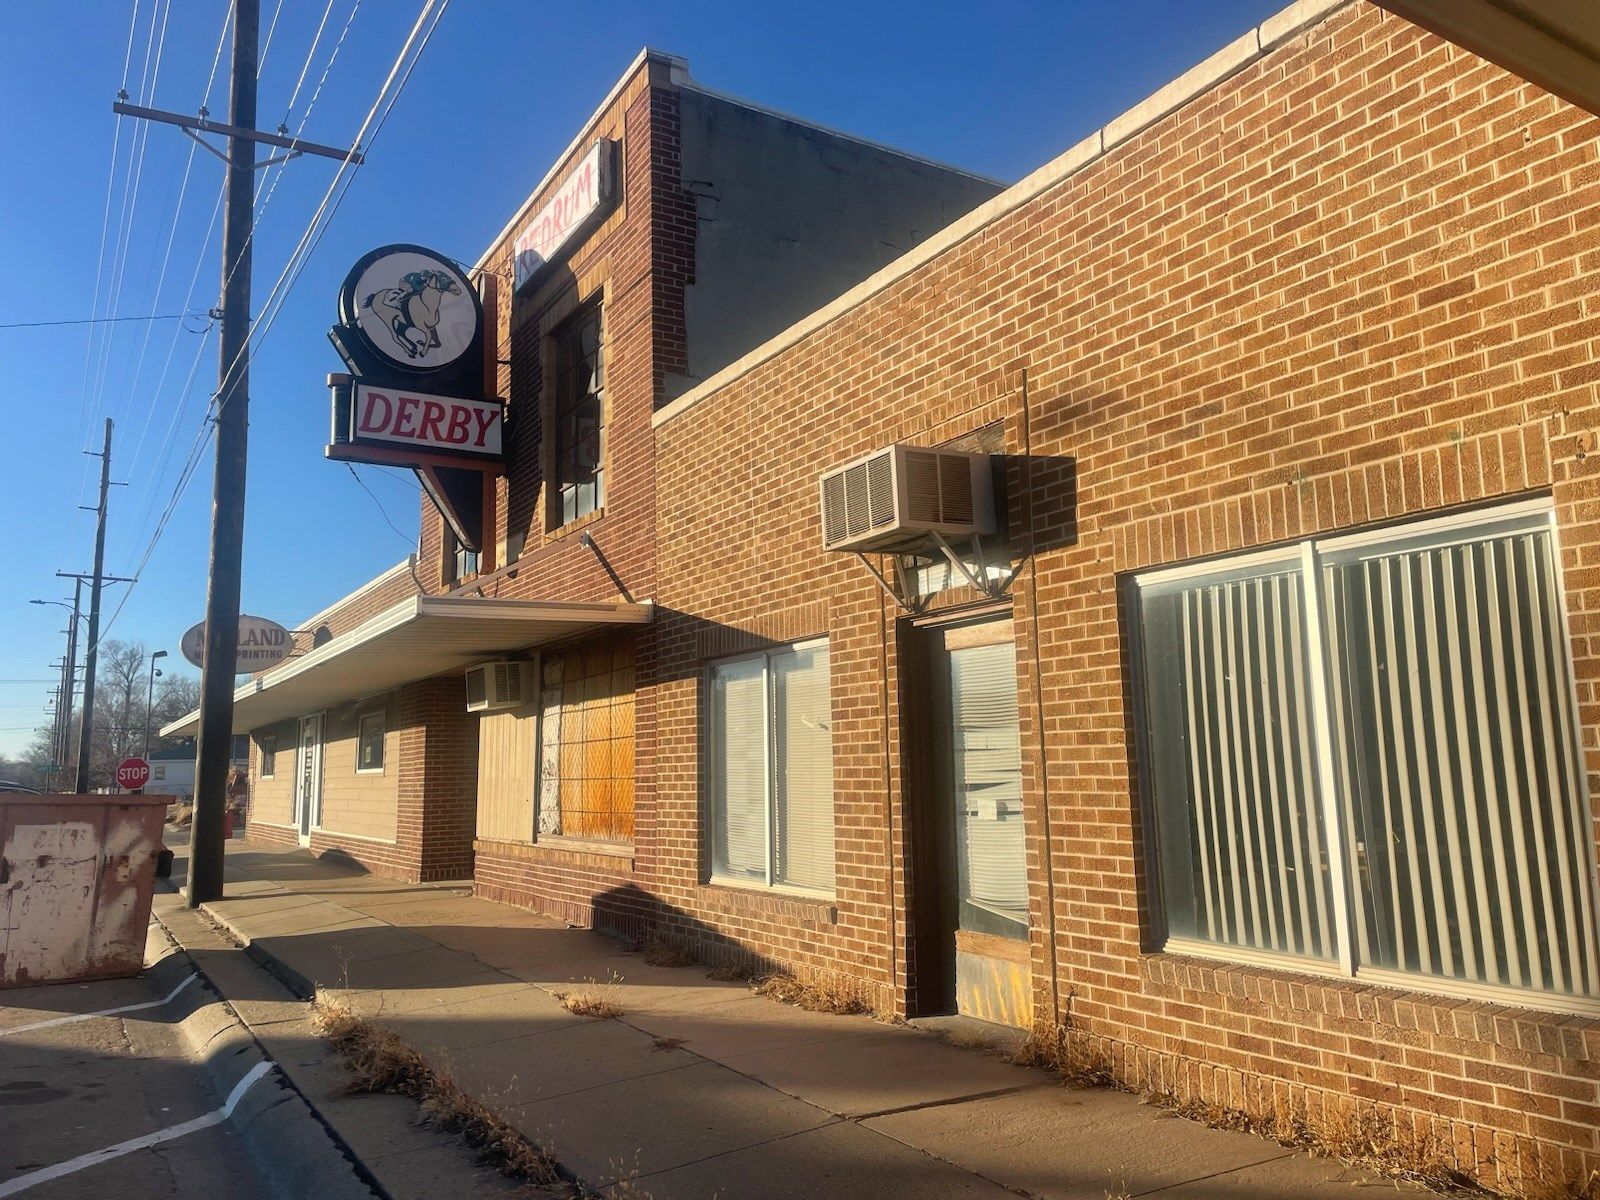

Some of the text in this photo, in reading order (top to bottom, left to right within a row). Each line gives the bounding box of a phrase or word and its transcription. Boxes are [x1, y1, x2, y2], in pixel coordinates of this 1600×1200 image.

[519, 162, 592, 284] REDRUM
[358, 392, 500, 447] DERBY
[119, 766, 148, 780] STOP
